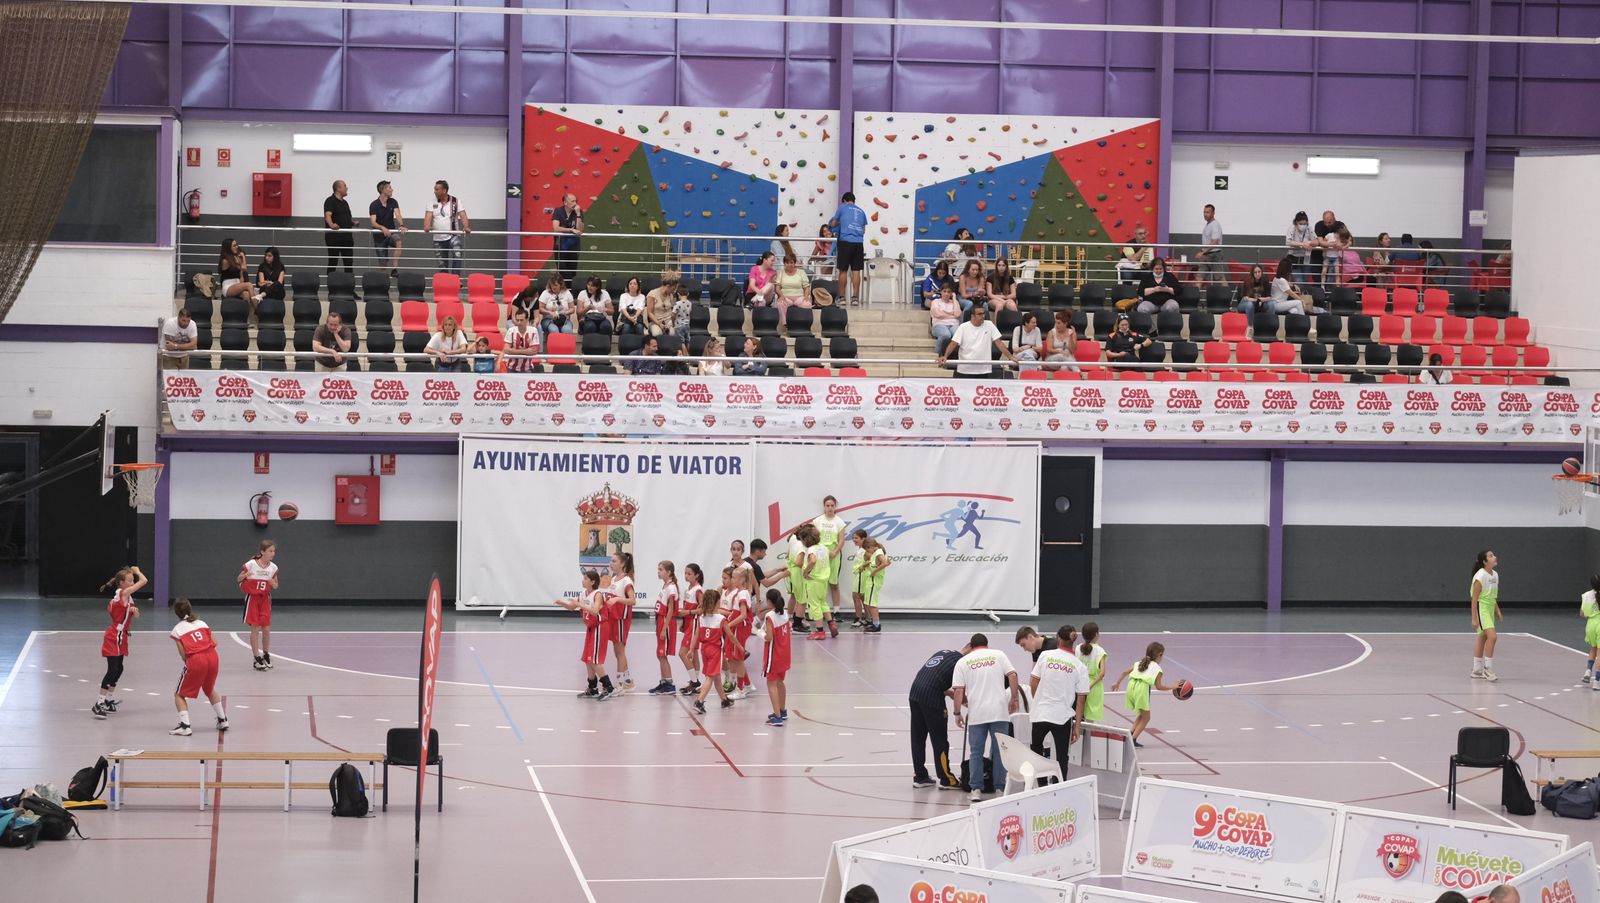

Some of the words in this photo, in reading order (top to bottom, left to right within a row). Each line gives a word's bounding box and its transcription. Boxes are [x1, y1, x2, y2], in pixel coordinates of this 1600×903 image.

[166, 376, 198, 387] COPA
[218, 376, 248, 388] COPA
[270, 378, 302, 390] COPA
[320, 376, 352, 389] COPA
[372, 378, 404, 390] COPA
[424, 378, 456, 390] COPA
[476, 380, 508, 391] COPA
[526, 380, 558, 392] COPA
[578, 380, 608, 392] COPA
[626, 380, 658, 392] COPA
[678, 380, 708, 393] COPA
[214, 386, 254, 398] COVAP
[266, 388, 306, 400] COVAP
[318, 388, 358, 400] COVAP
[728, 382, 758, 394] COPA
[778, 384, 810, 395] COPA
[826, 384, 858, 395] COPA
[876, 384, 908, 395] COPA
[926, 384, 956, 396] COPA
[976, 386, 1006, 397] COPA
[1024, 386, 1054, 397] COPA
[1072, 386, 1102, 397] COPA
[1120, 386, 1150, 398] COPA
[1168, 388, 1198, 399] COPA
[1216, 388, 1246, 399] COPA
[1264, 388, 1294, 400] COPA
[1312, 388, 1340, 400] COPA
[1360, 388, 1388, 400] COPA
[370, 389, 410, 400] COVAP
[422, 389, 462, 400] COVAP
[472, 389, 512, 400] COVAP
[524, 390, 564, 402] COVAP
[574, 390, 614, 402] COVAP
[624, 391, 664, 402] COVAP
[676, 392, 714, 404] COVAP
[726, 392, 764, 403] COVAP
[776, 393, 814, 404] COVAP
[826, 394, 864, 405] COVAP
[874, 394, 912, 405] COVAP
[922, 395, 960, 406] COVAP
[972, 395, 1010, 406] COVAP
[1408, 390, 1436, 401] COPA
[1452, 390, 1482, 402] COPA
[1500, 392, 1528, 403] COPA
[1546, 392, 1574, 403] COPA
[1020, 396, 1058, 407] COVAP
[1068, 396, 1108, 407] COVAP
[1118, 396, 1156, 408] COVAP
[1166, 398, 1202, 409] COVAP
[1214, 398, 1250, 409] COVAP
[1262, 398, 1298, 410] COVAP
[1310, 398, 1344, 410] COVAP
[1356, 399, 1392, 410] COVAP
[1402, 400, 1440, 411] COVAP
[1450, 400, 1486, 412] COVAP
[1498, 401, 1534, 412] COVAP
[473, 450, 630, 474] AYUNTAMIENTO
[637, 454, 662, 474] DE
[669, 455, 742, 475] VIATOR
[932, 555, 940, 564] y
[945, 553, 1009, 563] Educación
[256, 581, 266, 591] 19
[190, 631, 204, 643] 19
[705, 628, 711, 639] 8
[971, 661, 996, 670] COVAP
[1048, 662, 1074, 674] COVAP
[1032, 808, 1075, 832] Muévete
[1224, 807, 1267, 831] COPA
[1000, 824, 1019, 836] COVAP
[1217, 824, 1272, 848] COVAP
[1037, 823, 1075, 851] COVAP
[1192, 839, 1218, 852] MUCHO
[1238, 846, 1271, 860] DEPORTE
[1384, 843, 1415, 855] COVAP
[1436, 846, 1522, 874] Muévete
